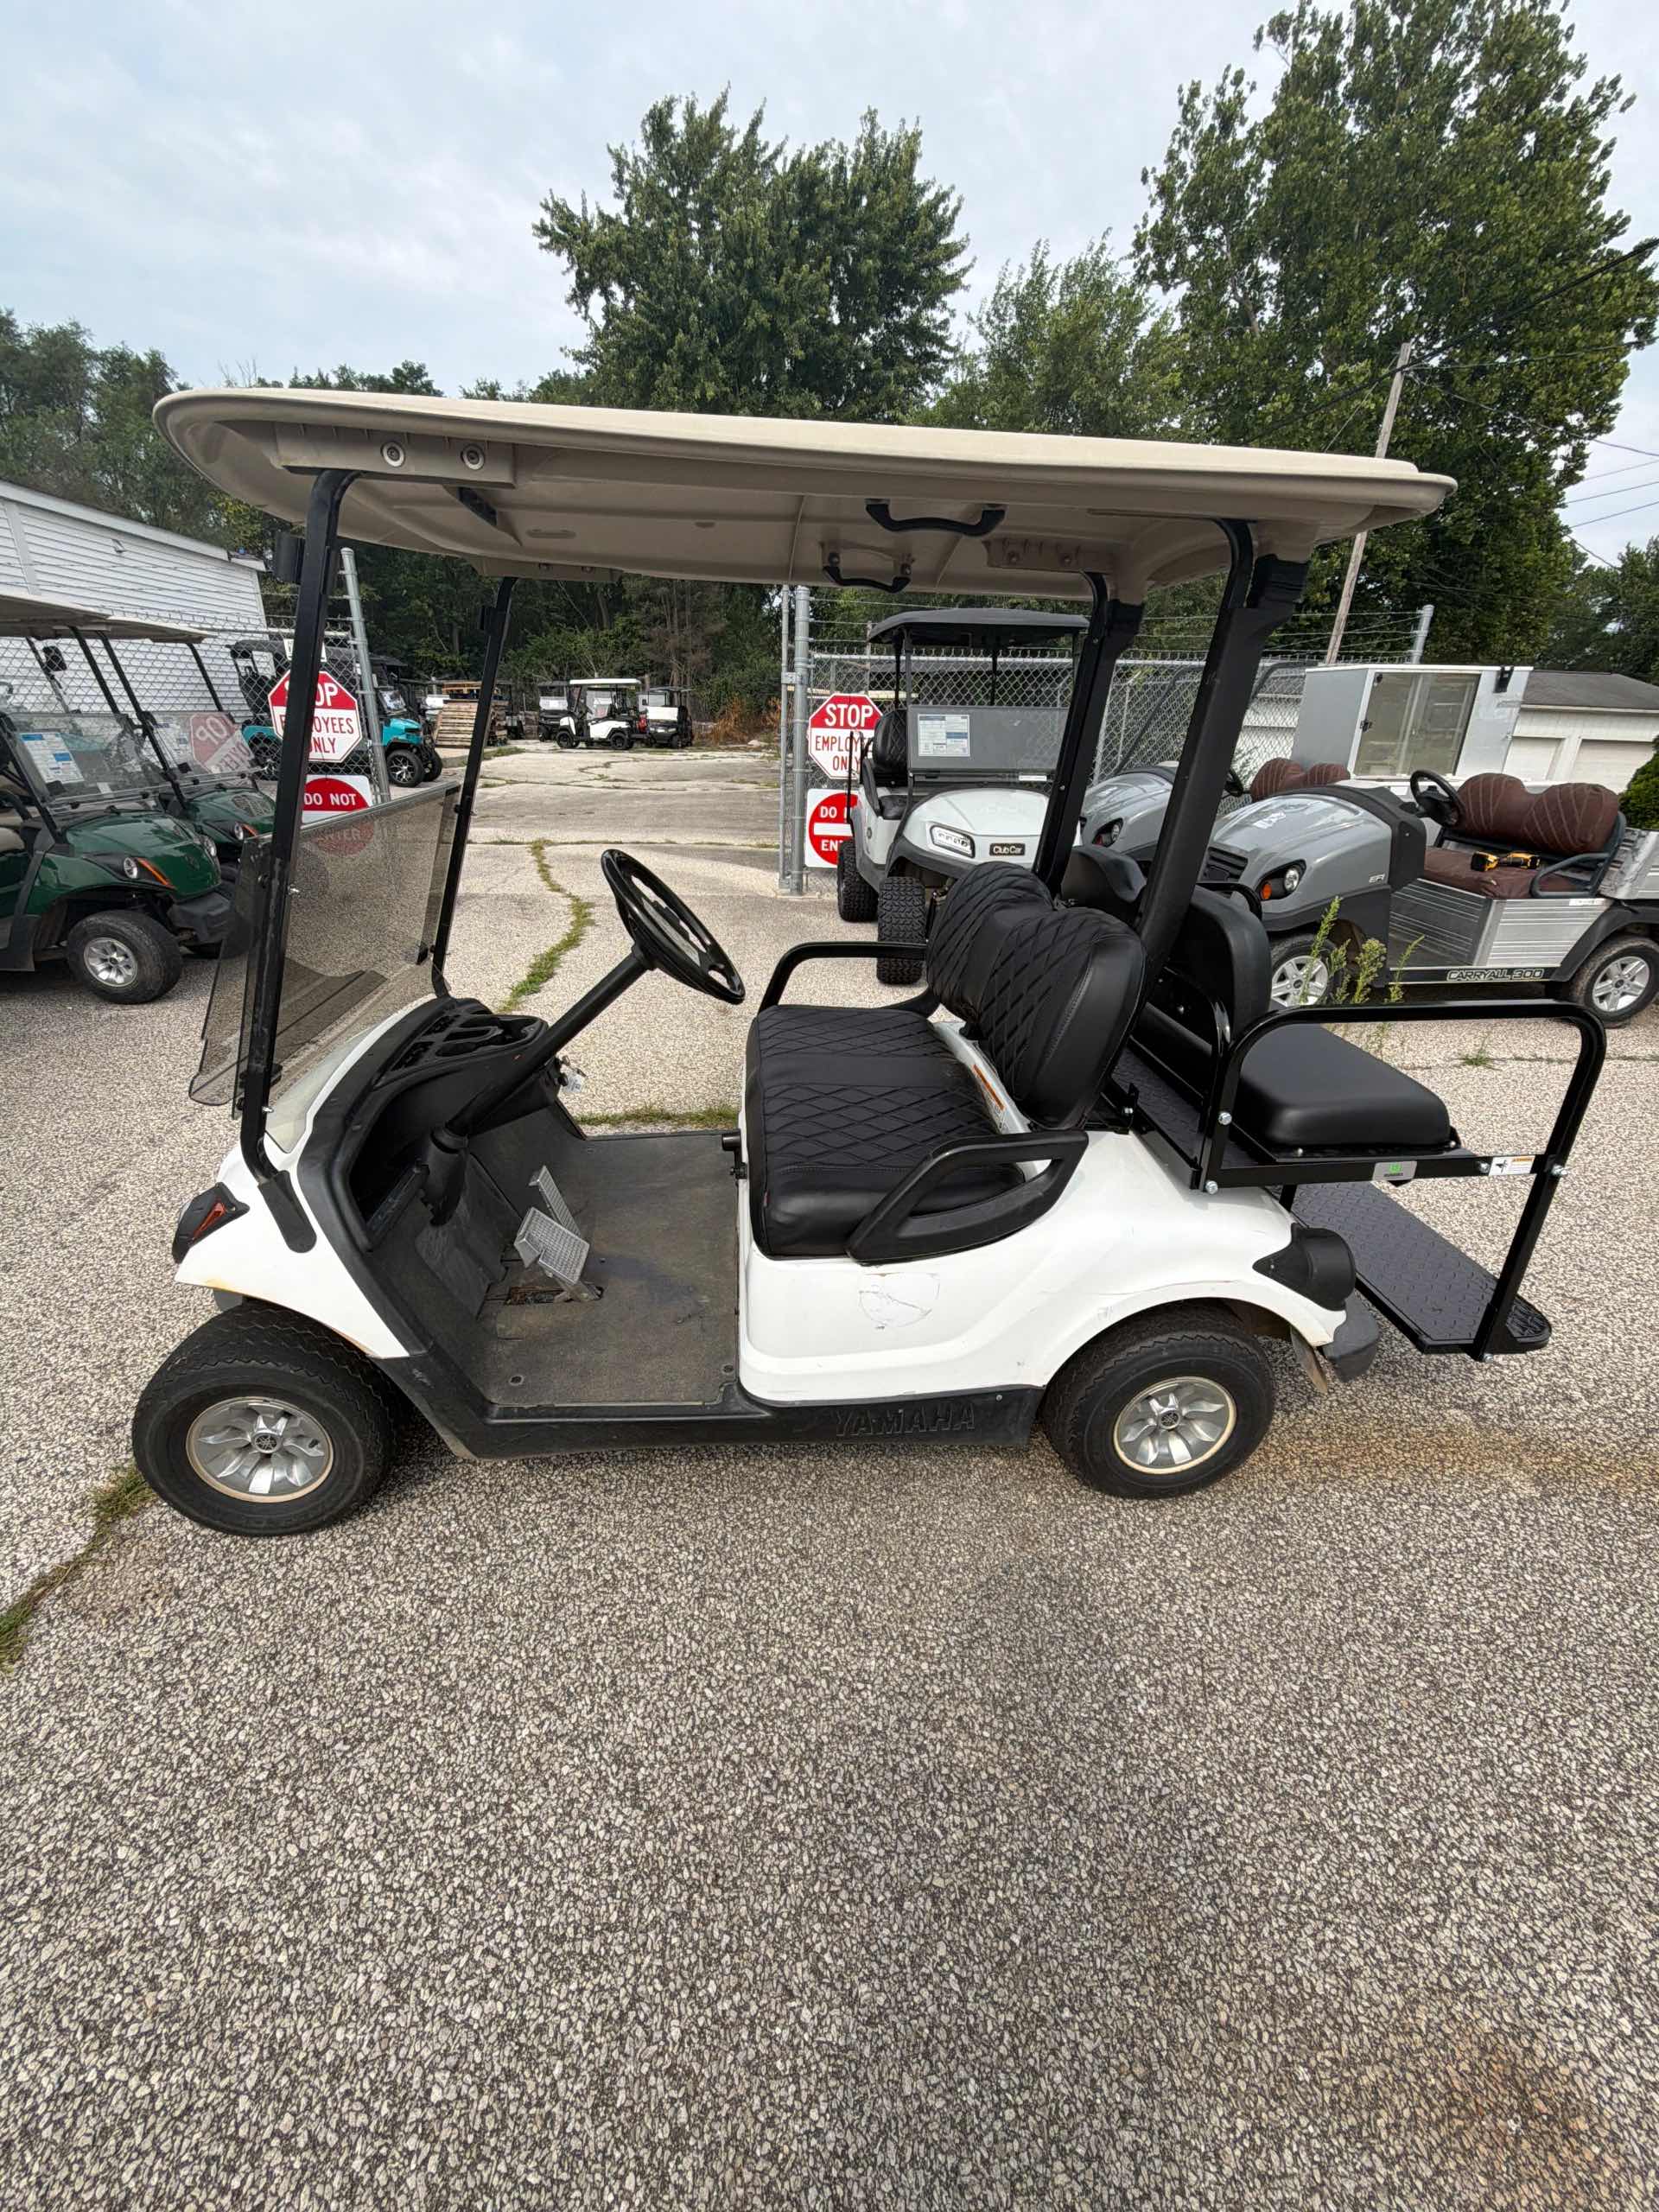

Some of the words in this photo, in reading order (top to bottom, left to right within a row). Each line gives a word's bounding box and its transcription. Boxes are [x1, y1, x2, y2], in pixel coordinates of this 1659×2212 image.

[824, 702, 874, 728] STOP
[309, 737, 336, 753] NLY
[832, 754, 861, 775] ONY
[303, 793, 323, 806] DO
[329, 793, 357, 806] NOT
[820, 805, 837, 819] DO
[1446, 969, 1510, 982] CARRYALL
[1512, 968, 1545, 981] 300
[836, 1402, 976, 1437] YAMAHA
